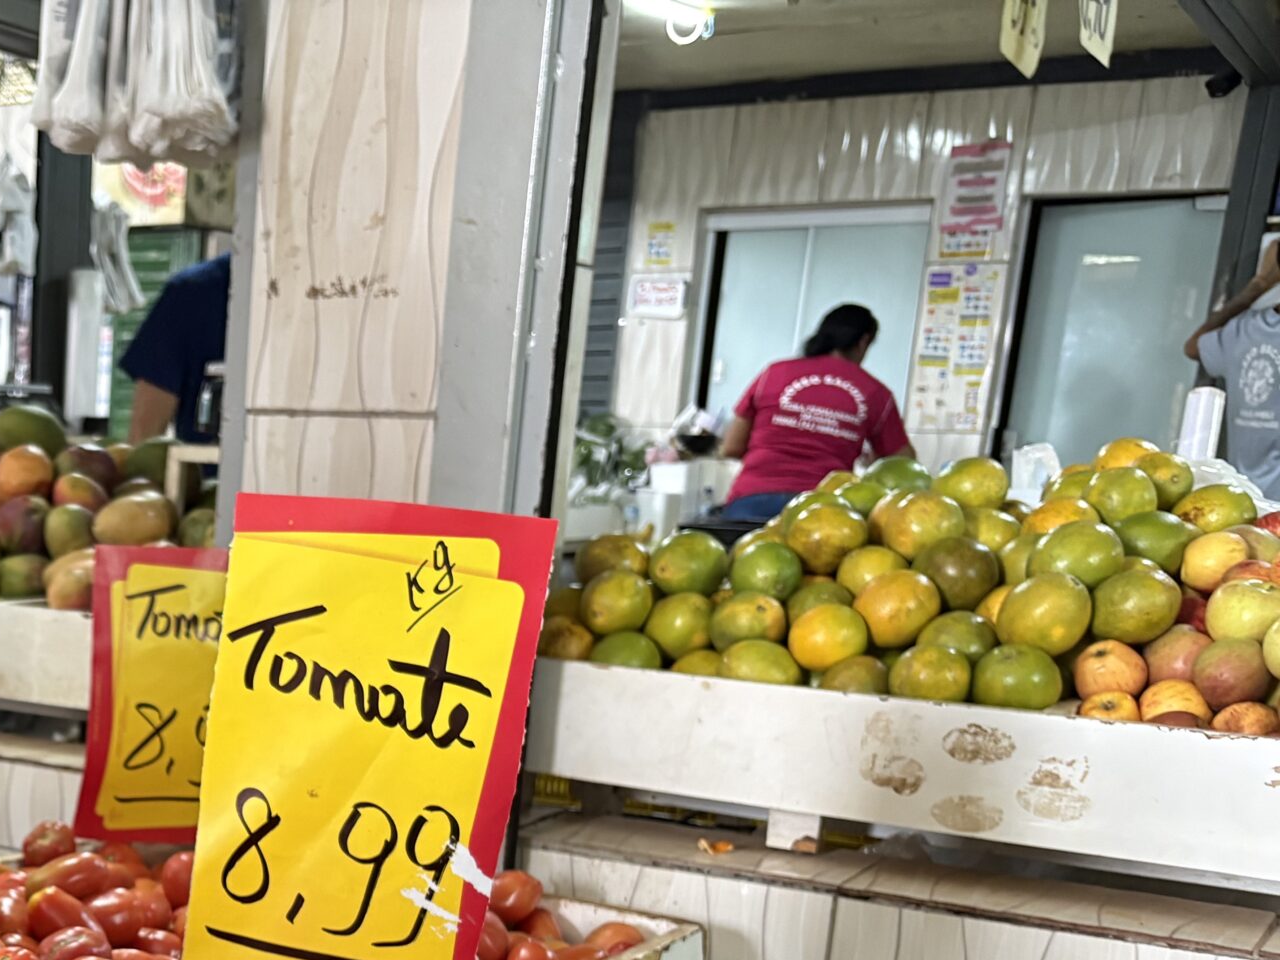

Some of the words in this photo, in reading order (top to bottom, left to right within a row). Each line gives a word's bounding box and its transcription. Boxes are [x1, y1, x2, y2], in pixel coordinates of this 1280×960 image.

[125, 584, 223, 641] Toma
[227, 604, 492, 749] Tomate
[221, 787, 461, 947] 8,99
